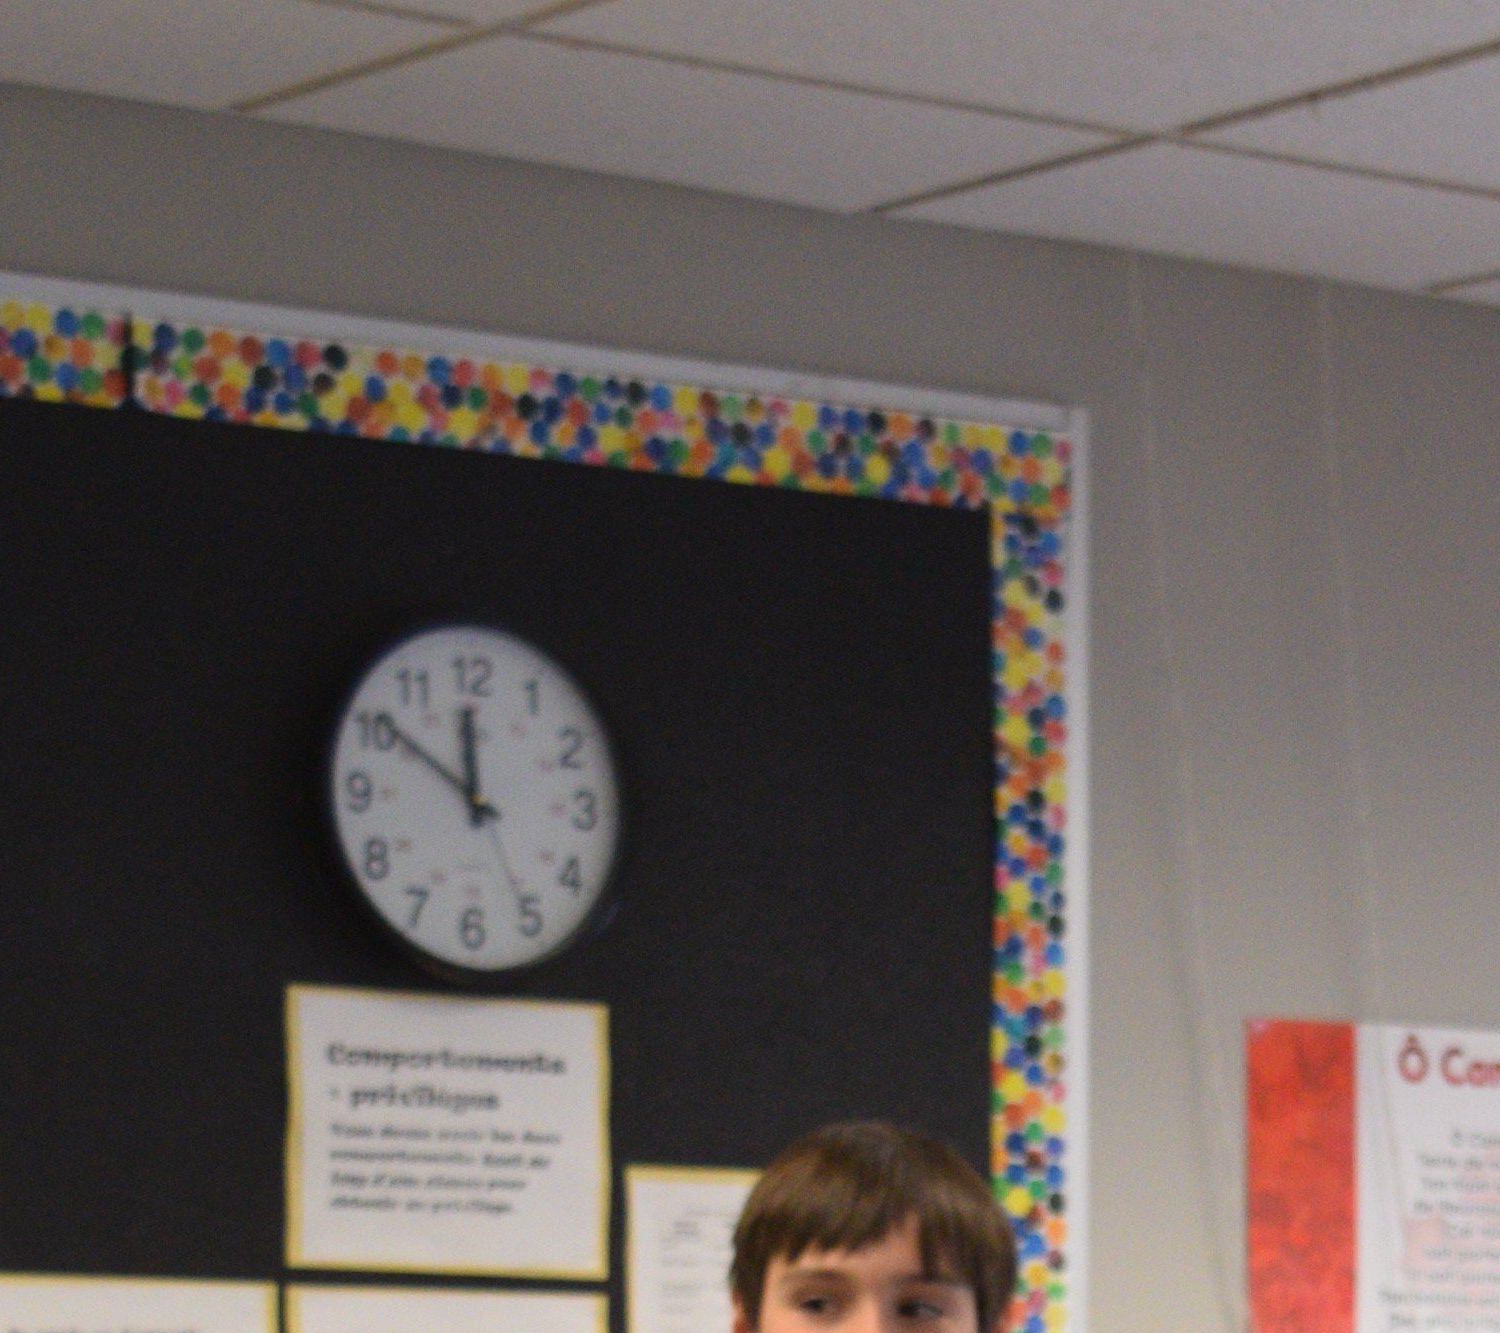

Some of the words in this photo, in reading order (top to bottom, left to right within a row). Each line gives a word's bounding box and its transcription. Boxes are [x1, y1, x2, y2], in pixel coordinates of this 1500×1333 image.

[397, 668, 430, 708] 11
[453, 655, 492, 699] 12
[524, 677, 540, 715] 1
[355, 711, 396, 751] 10
[558, 726, 583, 769] 2
[346, 770, 371, 813] 9
[571, 788, 597, 832] 3
[364, 837, 389, 880] 8
[558, 856, 581, 895] 4
[407, 885, 429, 928] 7
[458, 906, 486, 950] 6
[519, 897, 543, 937] 5
[1399, 1034, 1428, 1084] Ô
